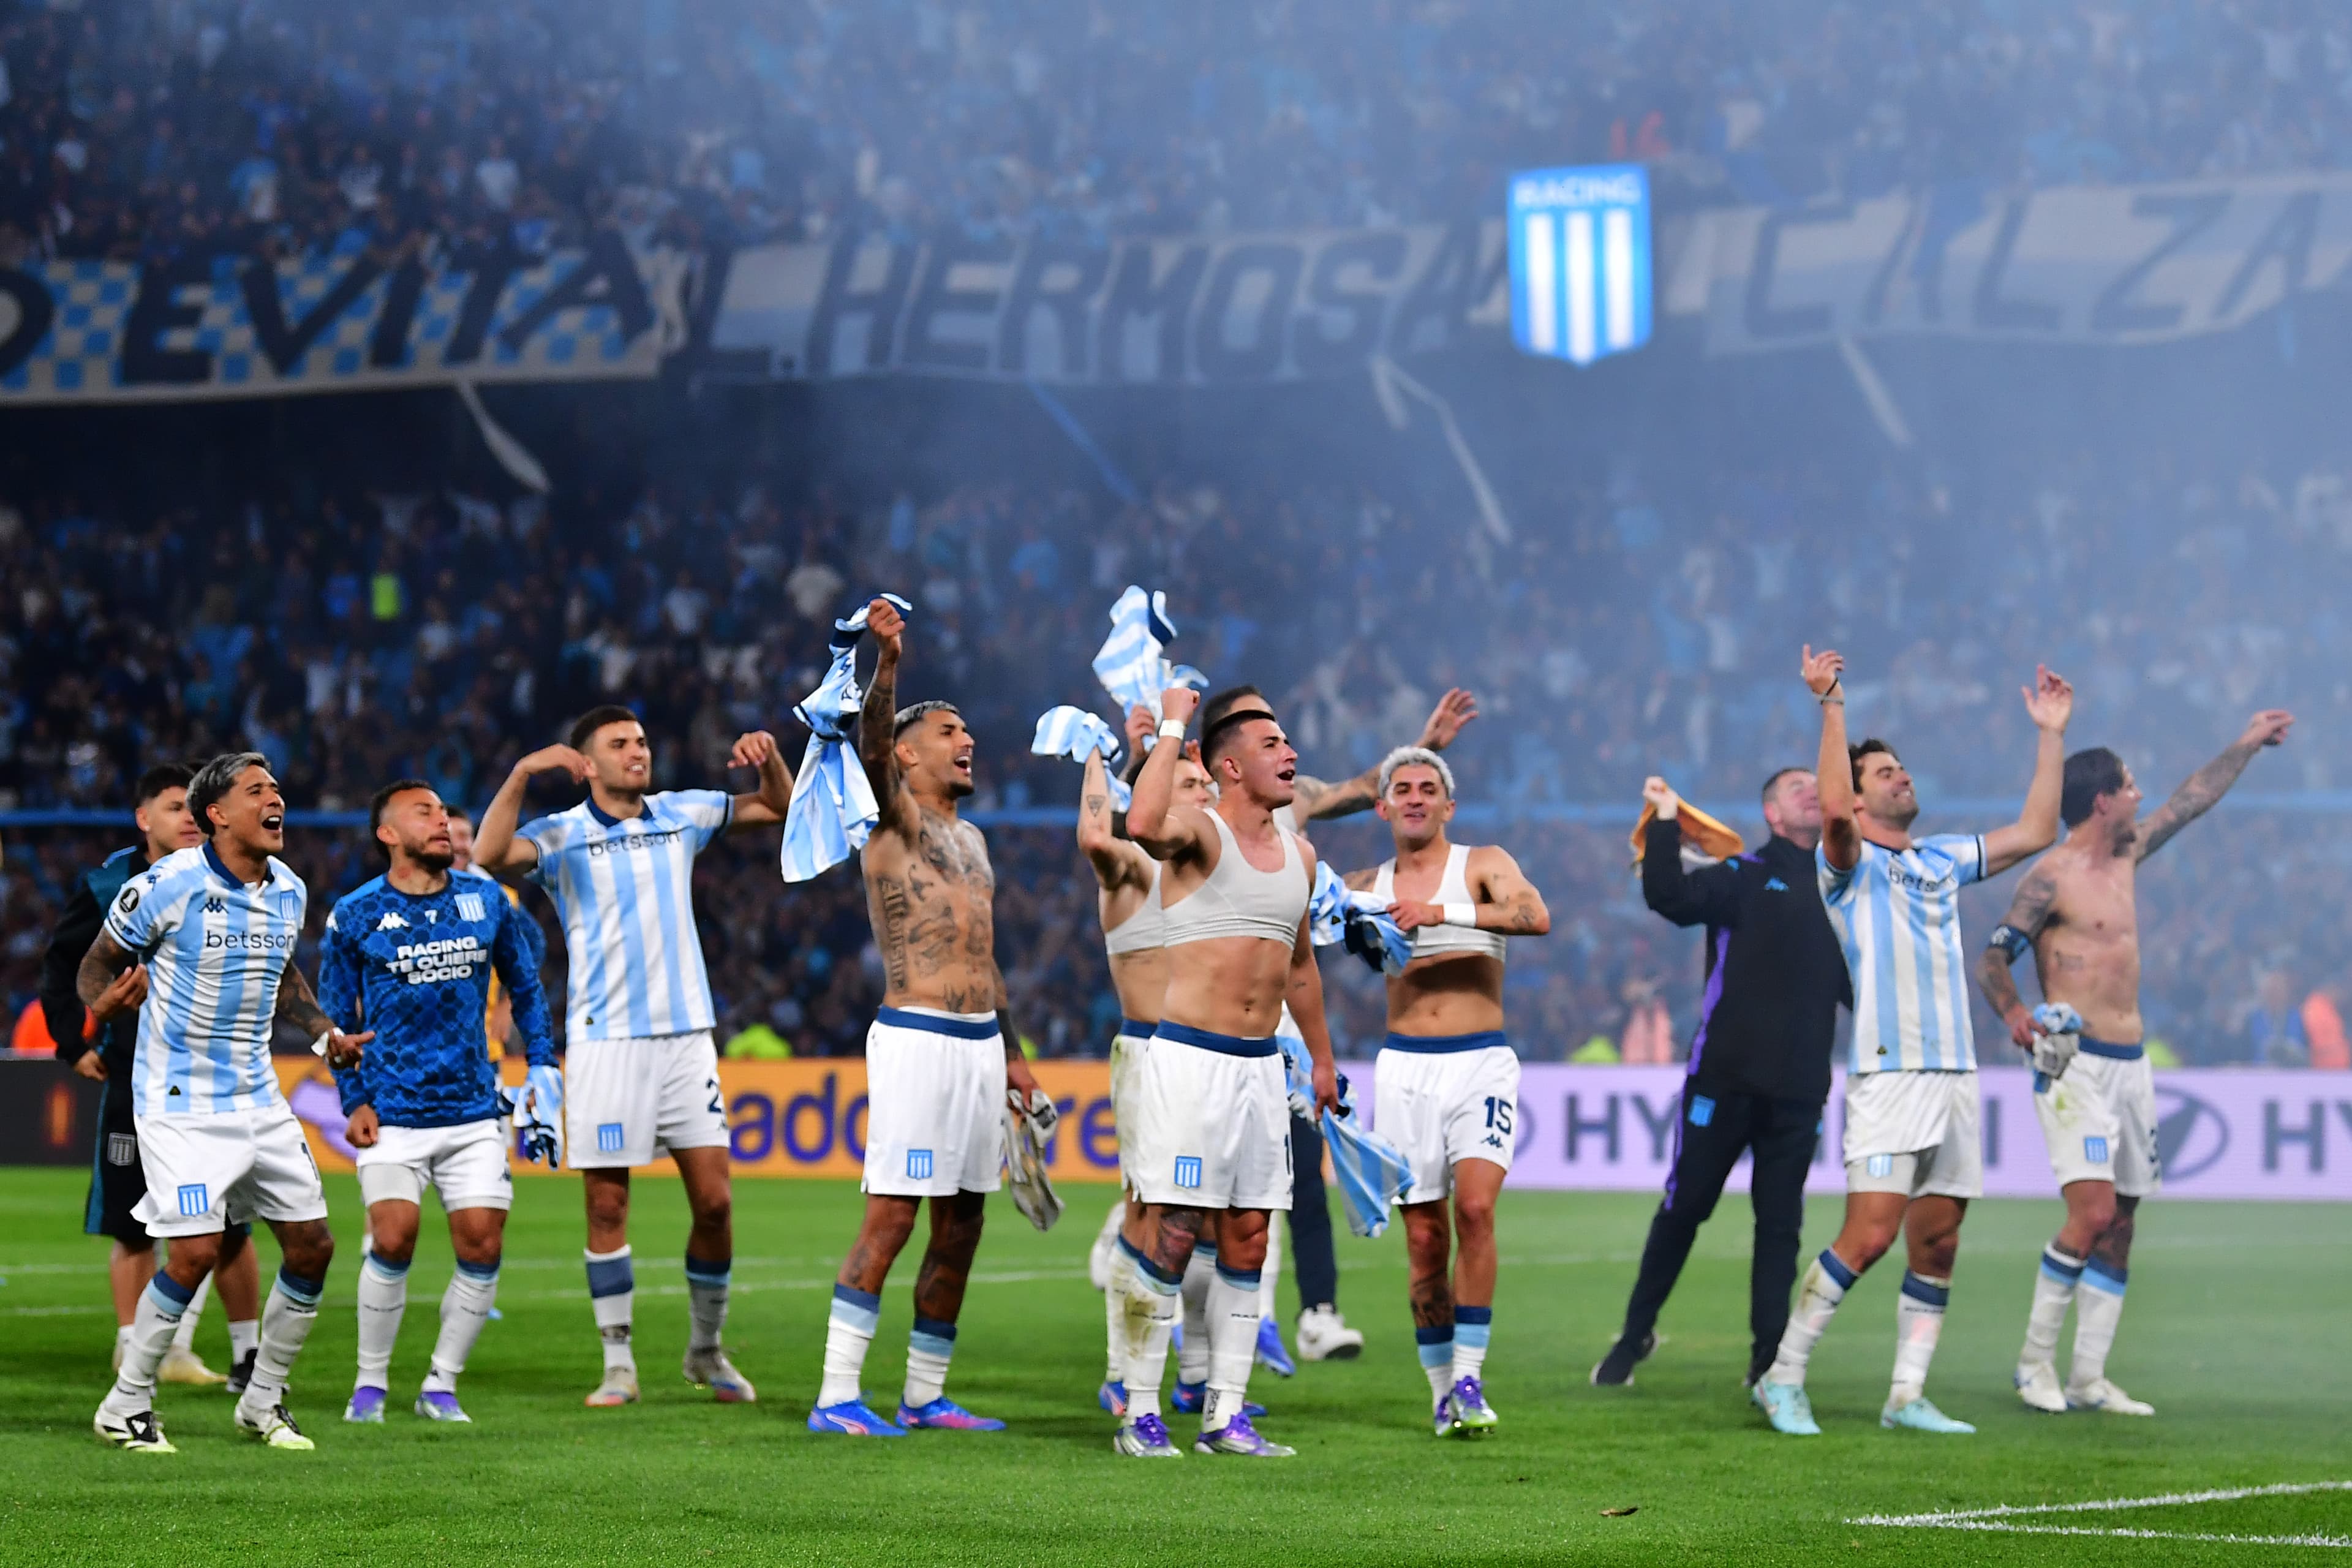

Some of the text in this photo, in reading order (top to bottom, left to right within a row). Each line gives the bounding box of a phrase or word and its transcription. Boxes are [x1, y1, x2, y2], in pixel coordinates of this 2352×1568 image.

[424, 910, 437, 924] 7
[397, 935, 477, 960] RACING
[407, 964, 472, 985] SOCIO
[1485, 1096, 1513, 1135] 15
